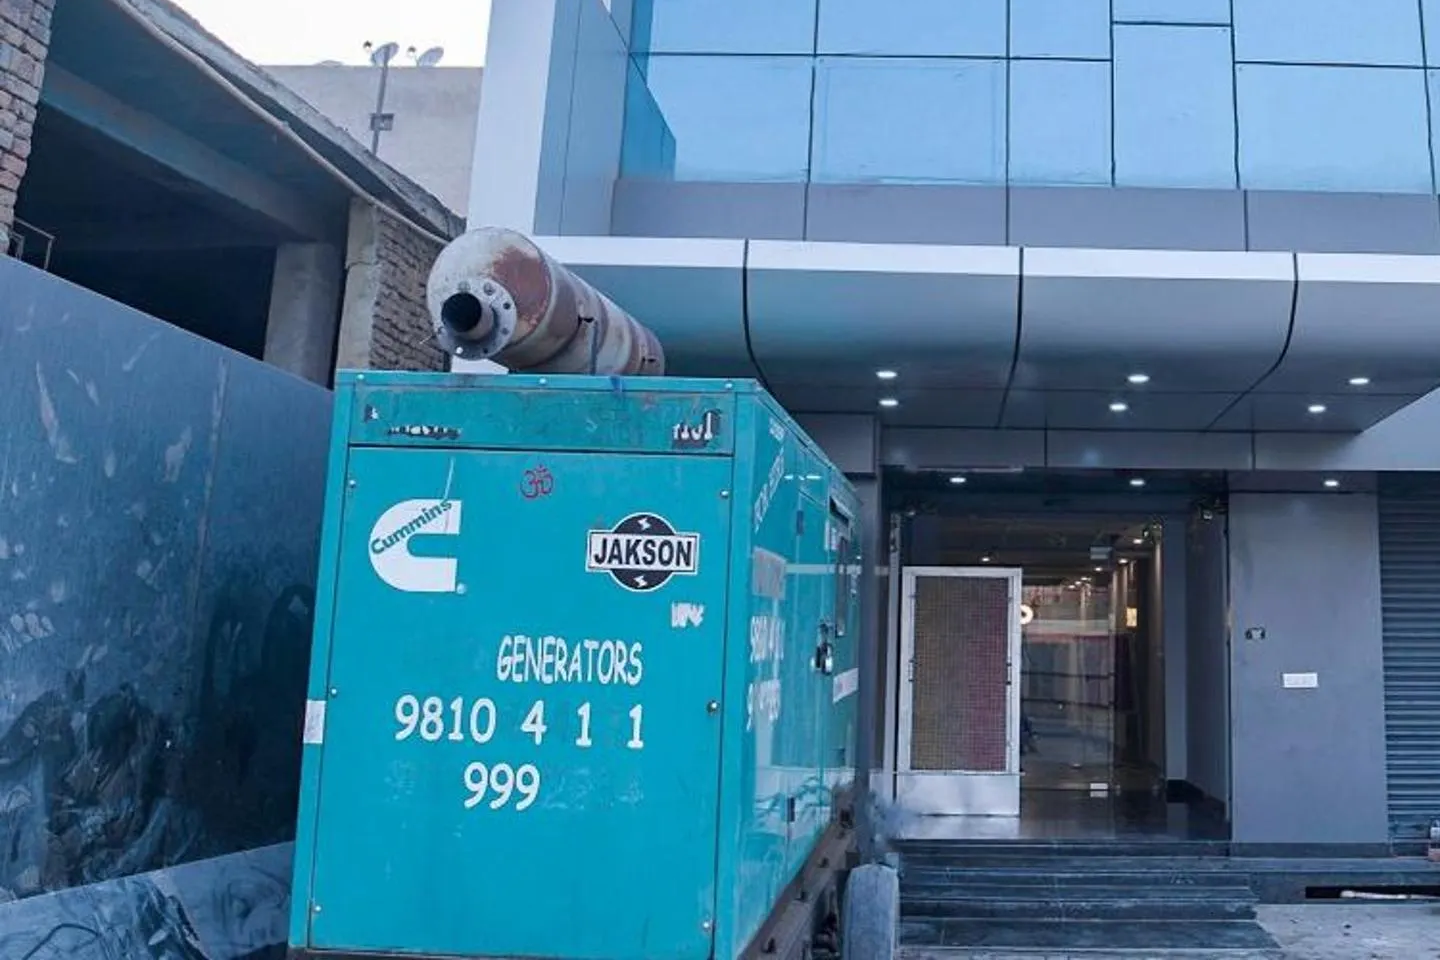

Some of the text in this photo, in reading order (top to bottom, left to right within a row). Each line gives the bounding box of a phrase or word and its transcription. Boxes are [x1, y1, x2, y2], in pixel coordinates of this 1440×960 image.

[371, 498, 452, 556] Cummins
[593, 538, 693, 568] JAKSON
[496, 634, 643, 686] GENERATORS
[394, 695, 644, 749] 9810 4 1 1
[463, 761, 541, 811] 999
